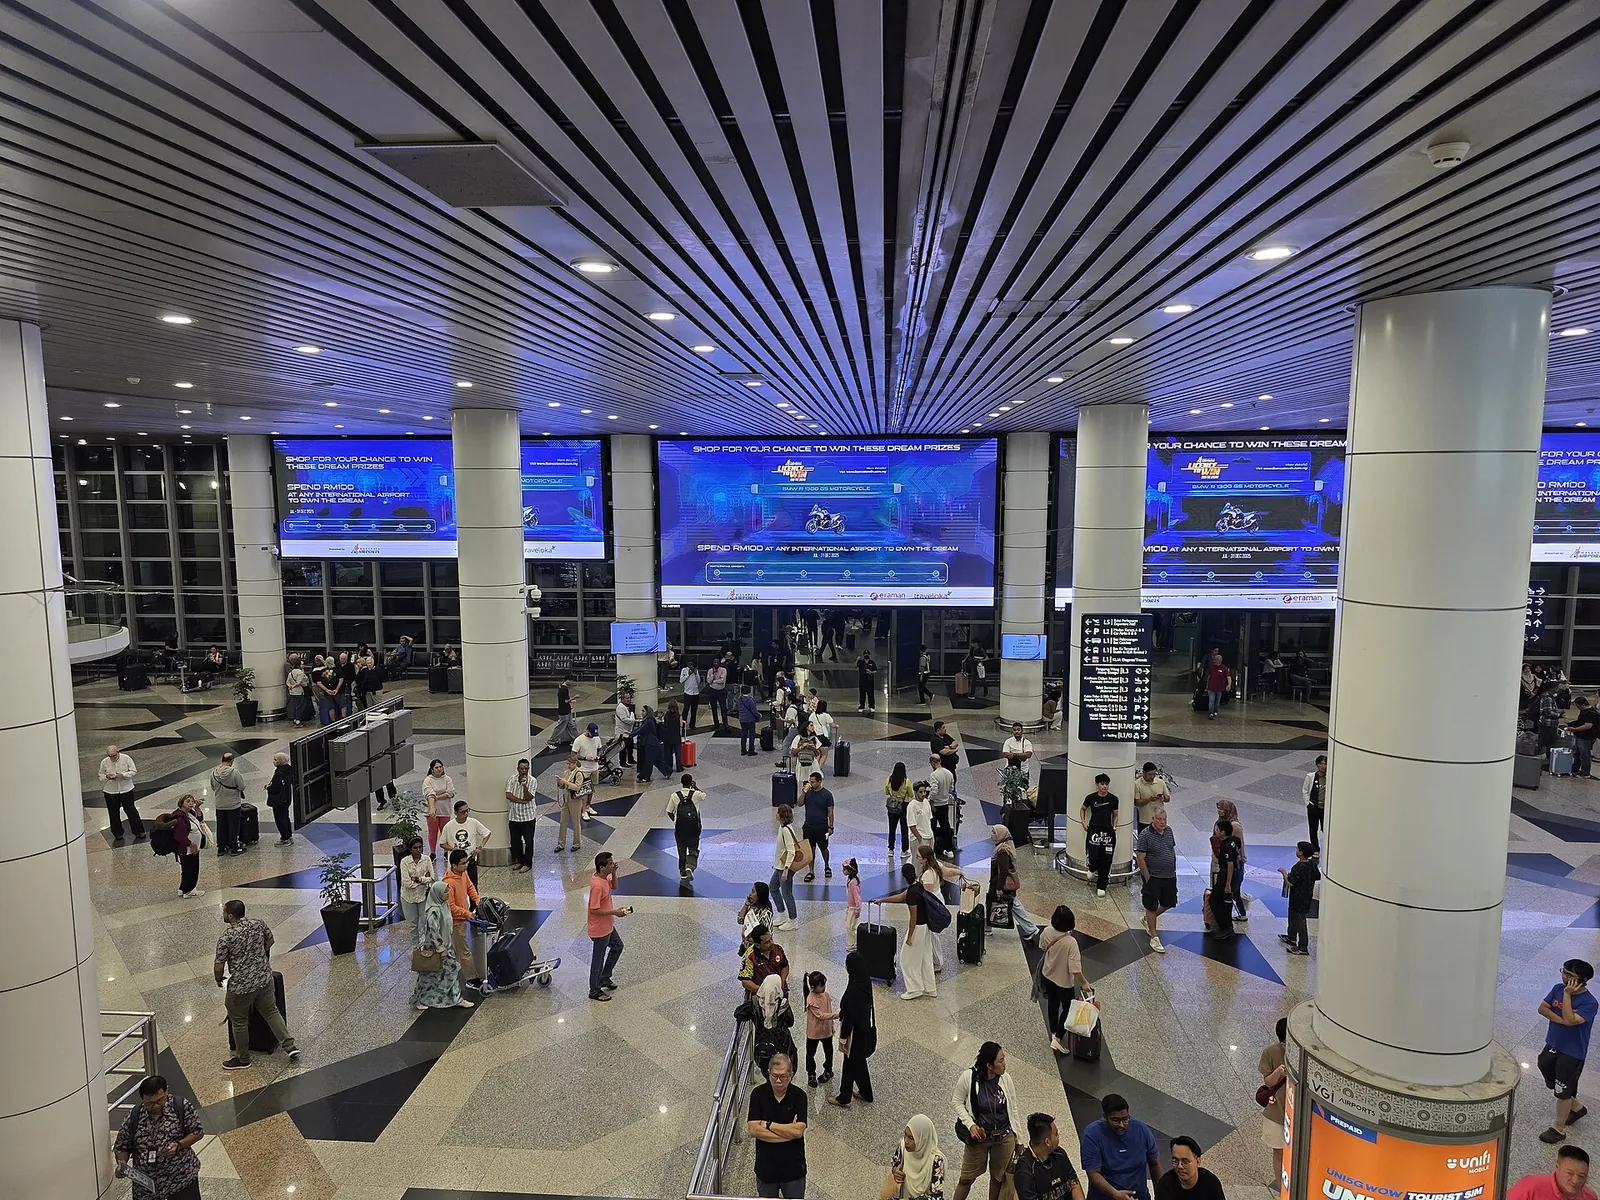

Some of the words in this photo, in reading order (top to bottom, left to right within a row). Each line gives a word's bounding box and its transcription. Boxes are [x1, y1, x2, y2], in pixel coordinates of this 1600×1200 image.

[1339, 1098, 1375, 1116] AIRPORTS
[1330, 1114, 1363, 1136] PREPAID
[1459, 1150, 1491, 1169] unifi
[1468, 1165, 1490, 1175] MOBILE
[1326, 1168, 1364, 1189] UNI5G
[1365, 1184, 1402, 1198] WOW
[1407, 1192, 1463, 1200] TOURIST
[1464, 1187, 1484, 1199] SIM
